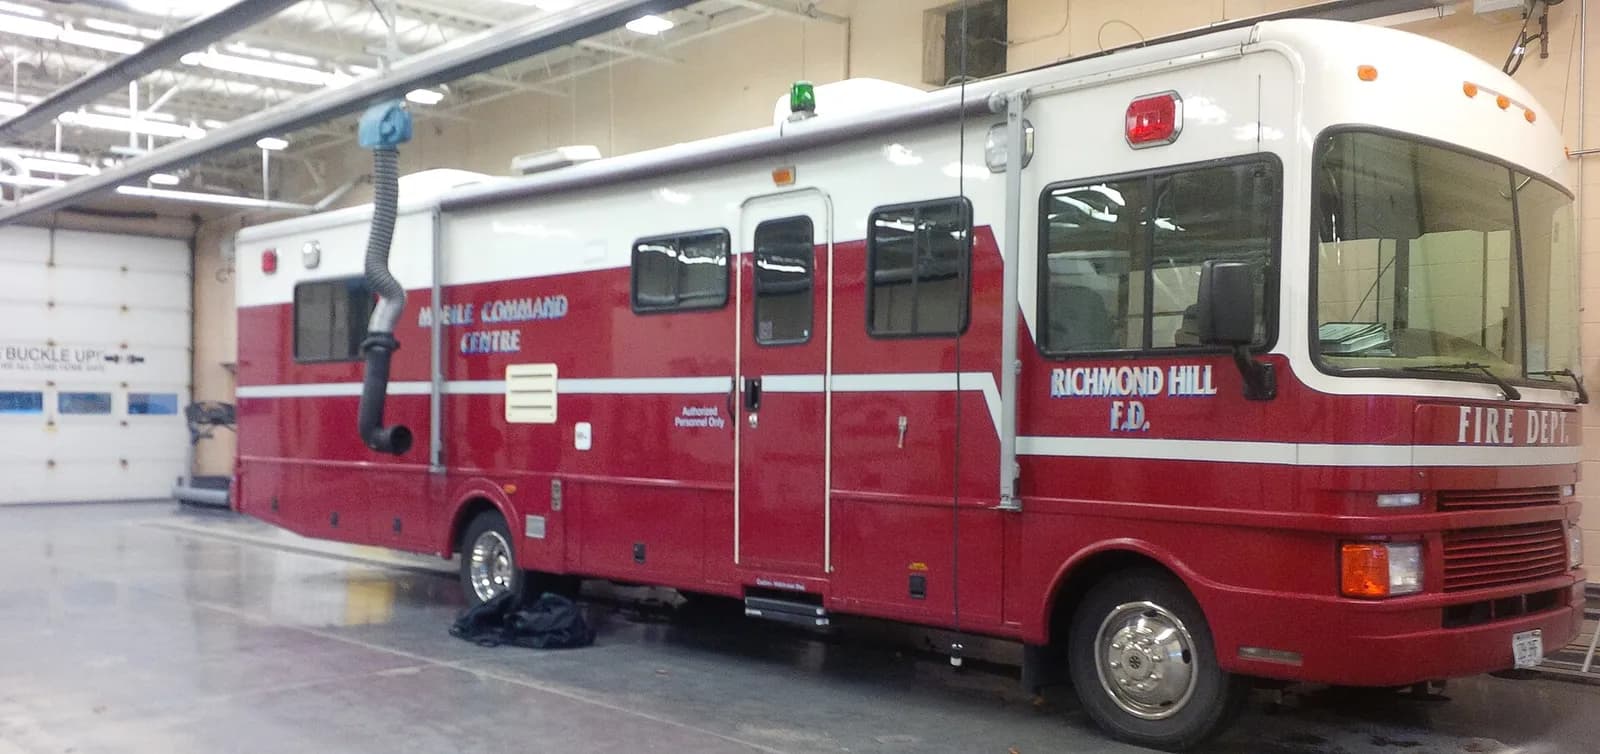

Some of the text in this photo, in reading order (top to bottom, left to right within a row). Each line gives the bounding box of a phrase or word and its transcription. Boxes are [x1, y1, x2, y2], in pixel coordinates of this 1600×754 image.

[481, 295, 569, 323] COMMAND
[6, 347, 69, 362] BUCKLE
[460, 330, 521, 354] CENTRE
[1051, 365, 1217, 397] RICHMOND HILL
[674, 416, 725, 428] Personnel Only
[682, 406, 718, 416] Authorized
[1110, 401, 1150, 431] F.D.
[1458, 406, 1569, 443] FIRE DEPT.
